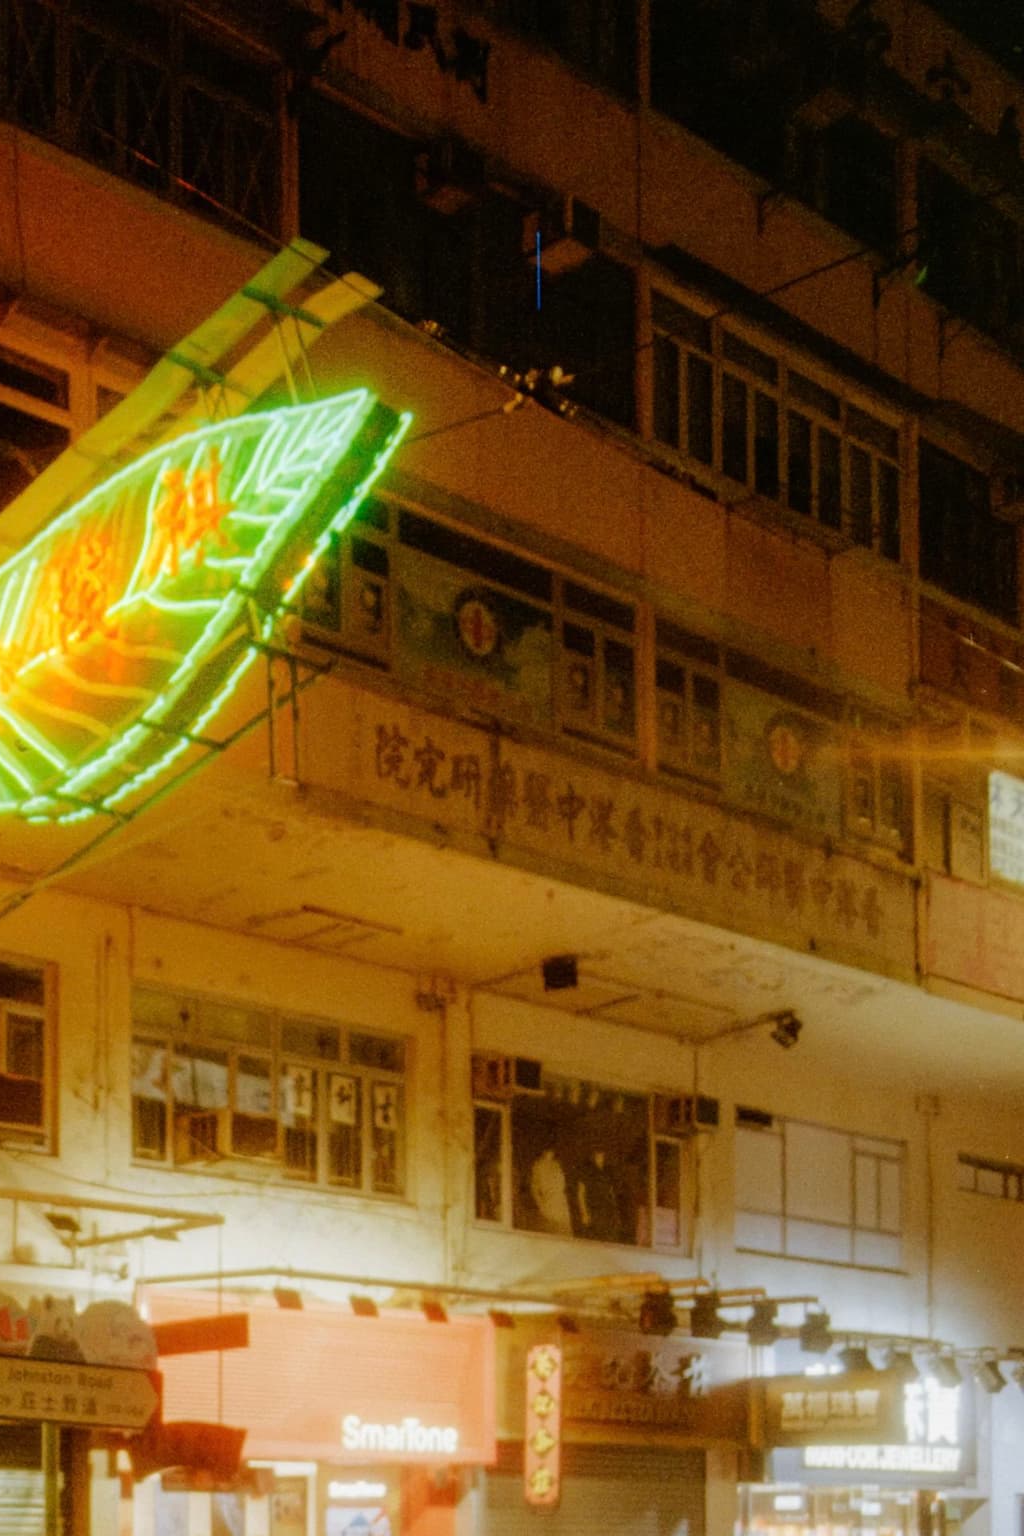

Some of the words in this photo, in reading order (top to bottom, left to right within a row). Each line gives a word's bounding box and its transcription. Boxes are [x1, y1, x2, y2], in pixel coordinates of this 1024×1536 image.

[8, 1367, 73, 1386] Johnston
[78, 1373, 114, 1391] Road
[342, 1415, 459, 1454] SmarTone
